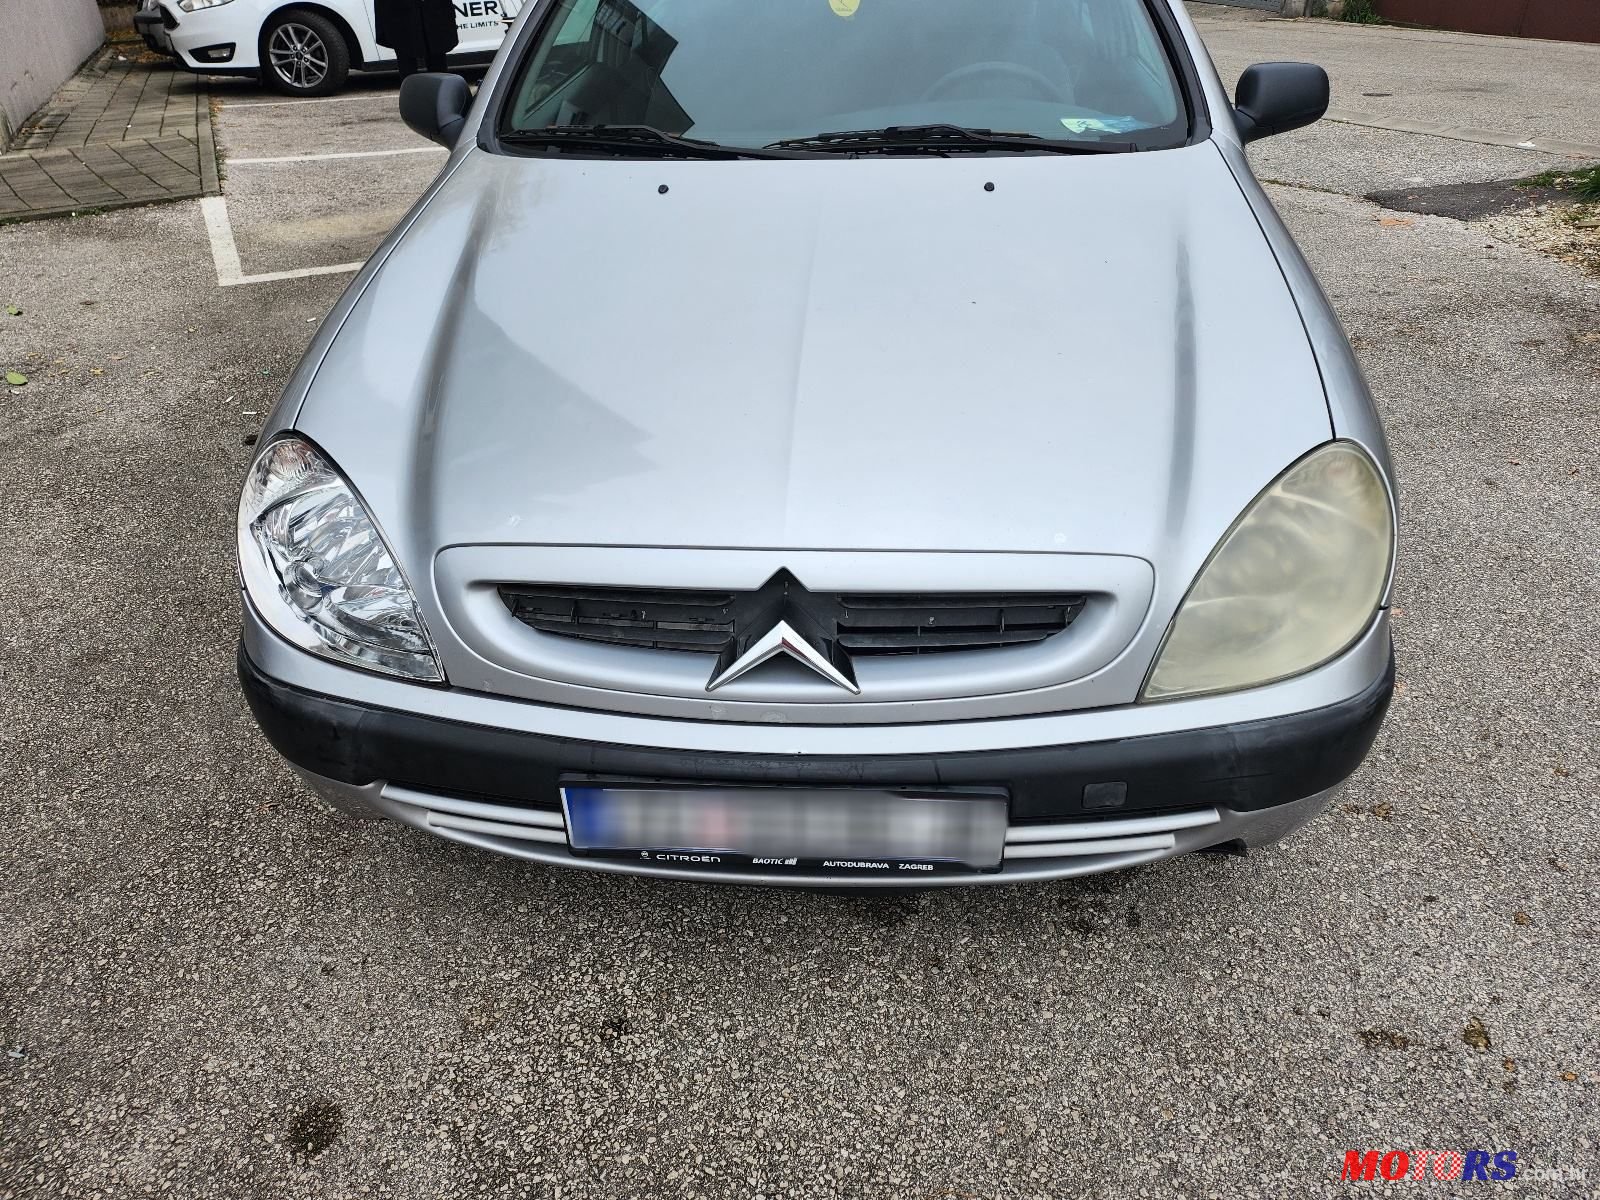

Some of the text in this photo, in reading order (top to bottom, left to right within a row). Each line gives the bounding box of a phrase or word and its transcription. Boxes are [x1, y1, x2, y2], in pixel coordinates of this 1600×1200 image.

[470, 21, 499, 29] LIMITS
[822, 860, 934, 871] AUTODUBRAVA ZAGREB
